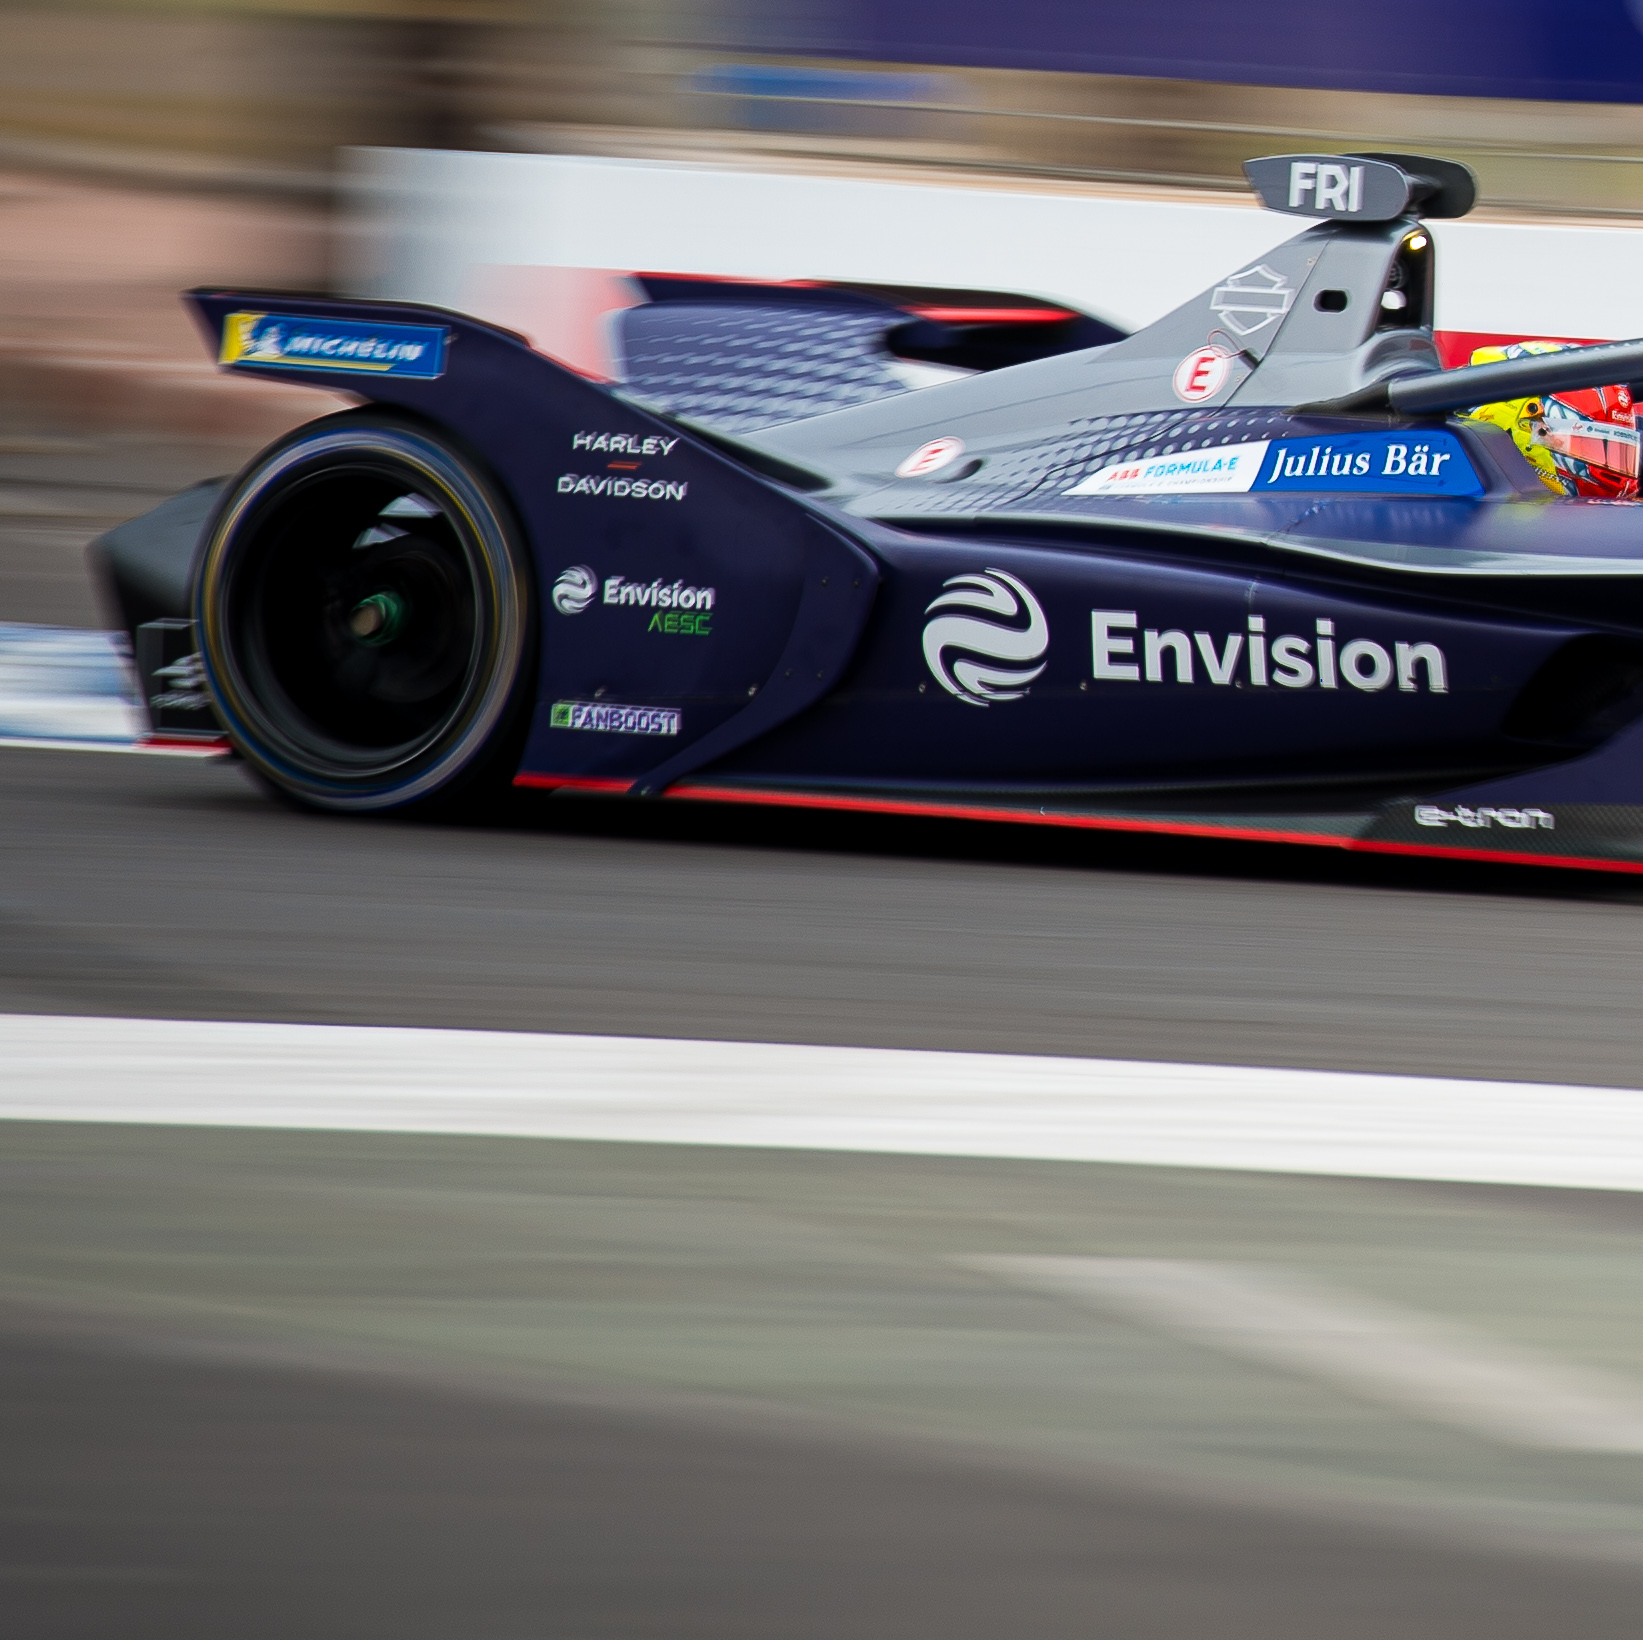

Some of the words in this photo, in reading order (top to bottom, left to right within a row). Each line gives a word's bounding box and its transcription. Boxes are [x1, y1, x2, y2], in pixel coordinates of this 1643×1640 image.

[1289, 162, 1365, 212] FRI
[284, 334, 428, 362] MICHELIN
[1184, 356, 1216, 392] E
[572, 430, 681, 456] HARLEY
[1107, 468, 1141, 482] ABB
[1267, 445, 1371, 484] Julius
[1381, 444, 1451, 476] Bär
[557, 473, 688, 501] DAVIDSON
[603, 576, 715, 610] Envision
[1091, 609, 1449, 693] Envision
[571, 703, 677, 734] FANBOOST
[1414, 804, 1555, 830] e-tron
